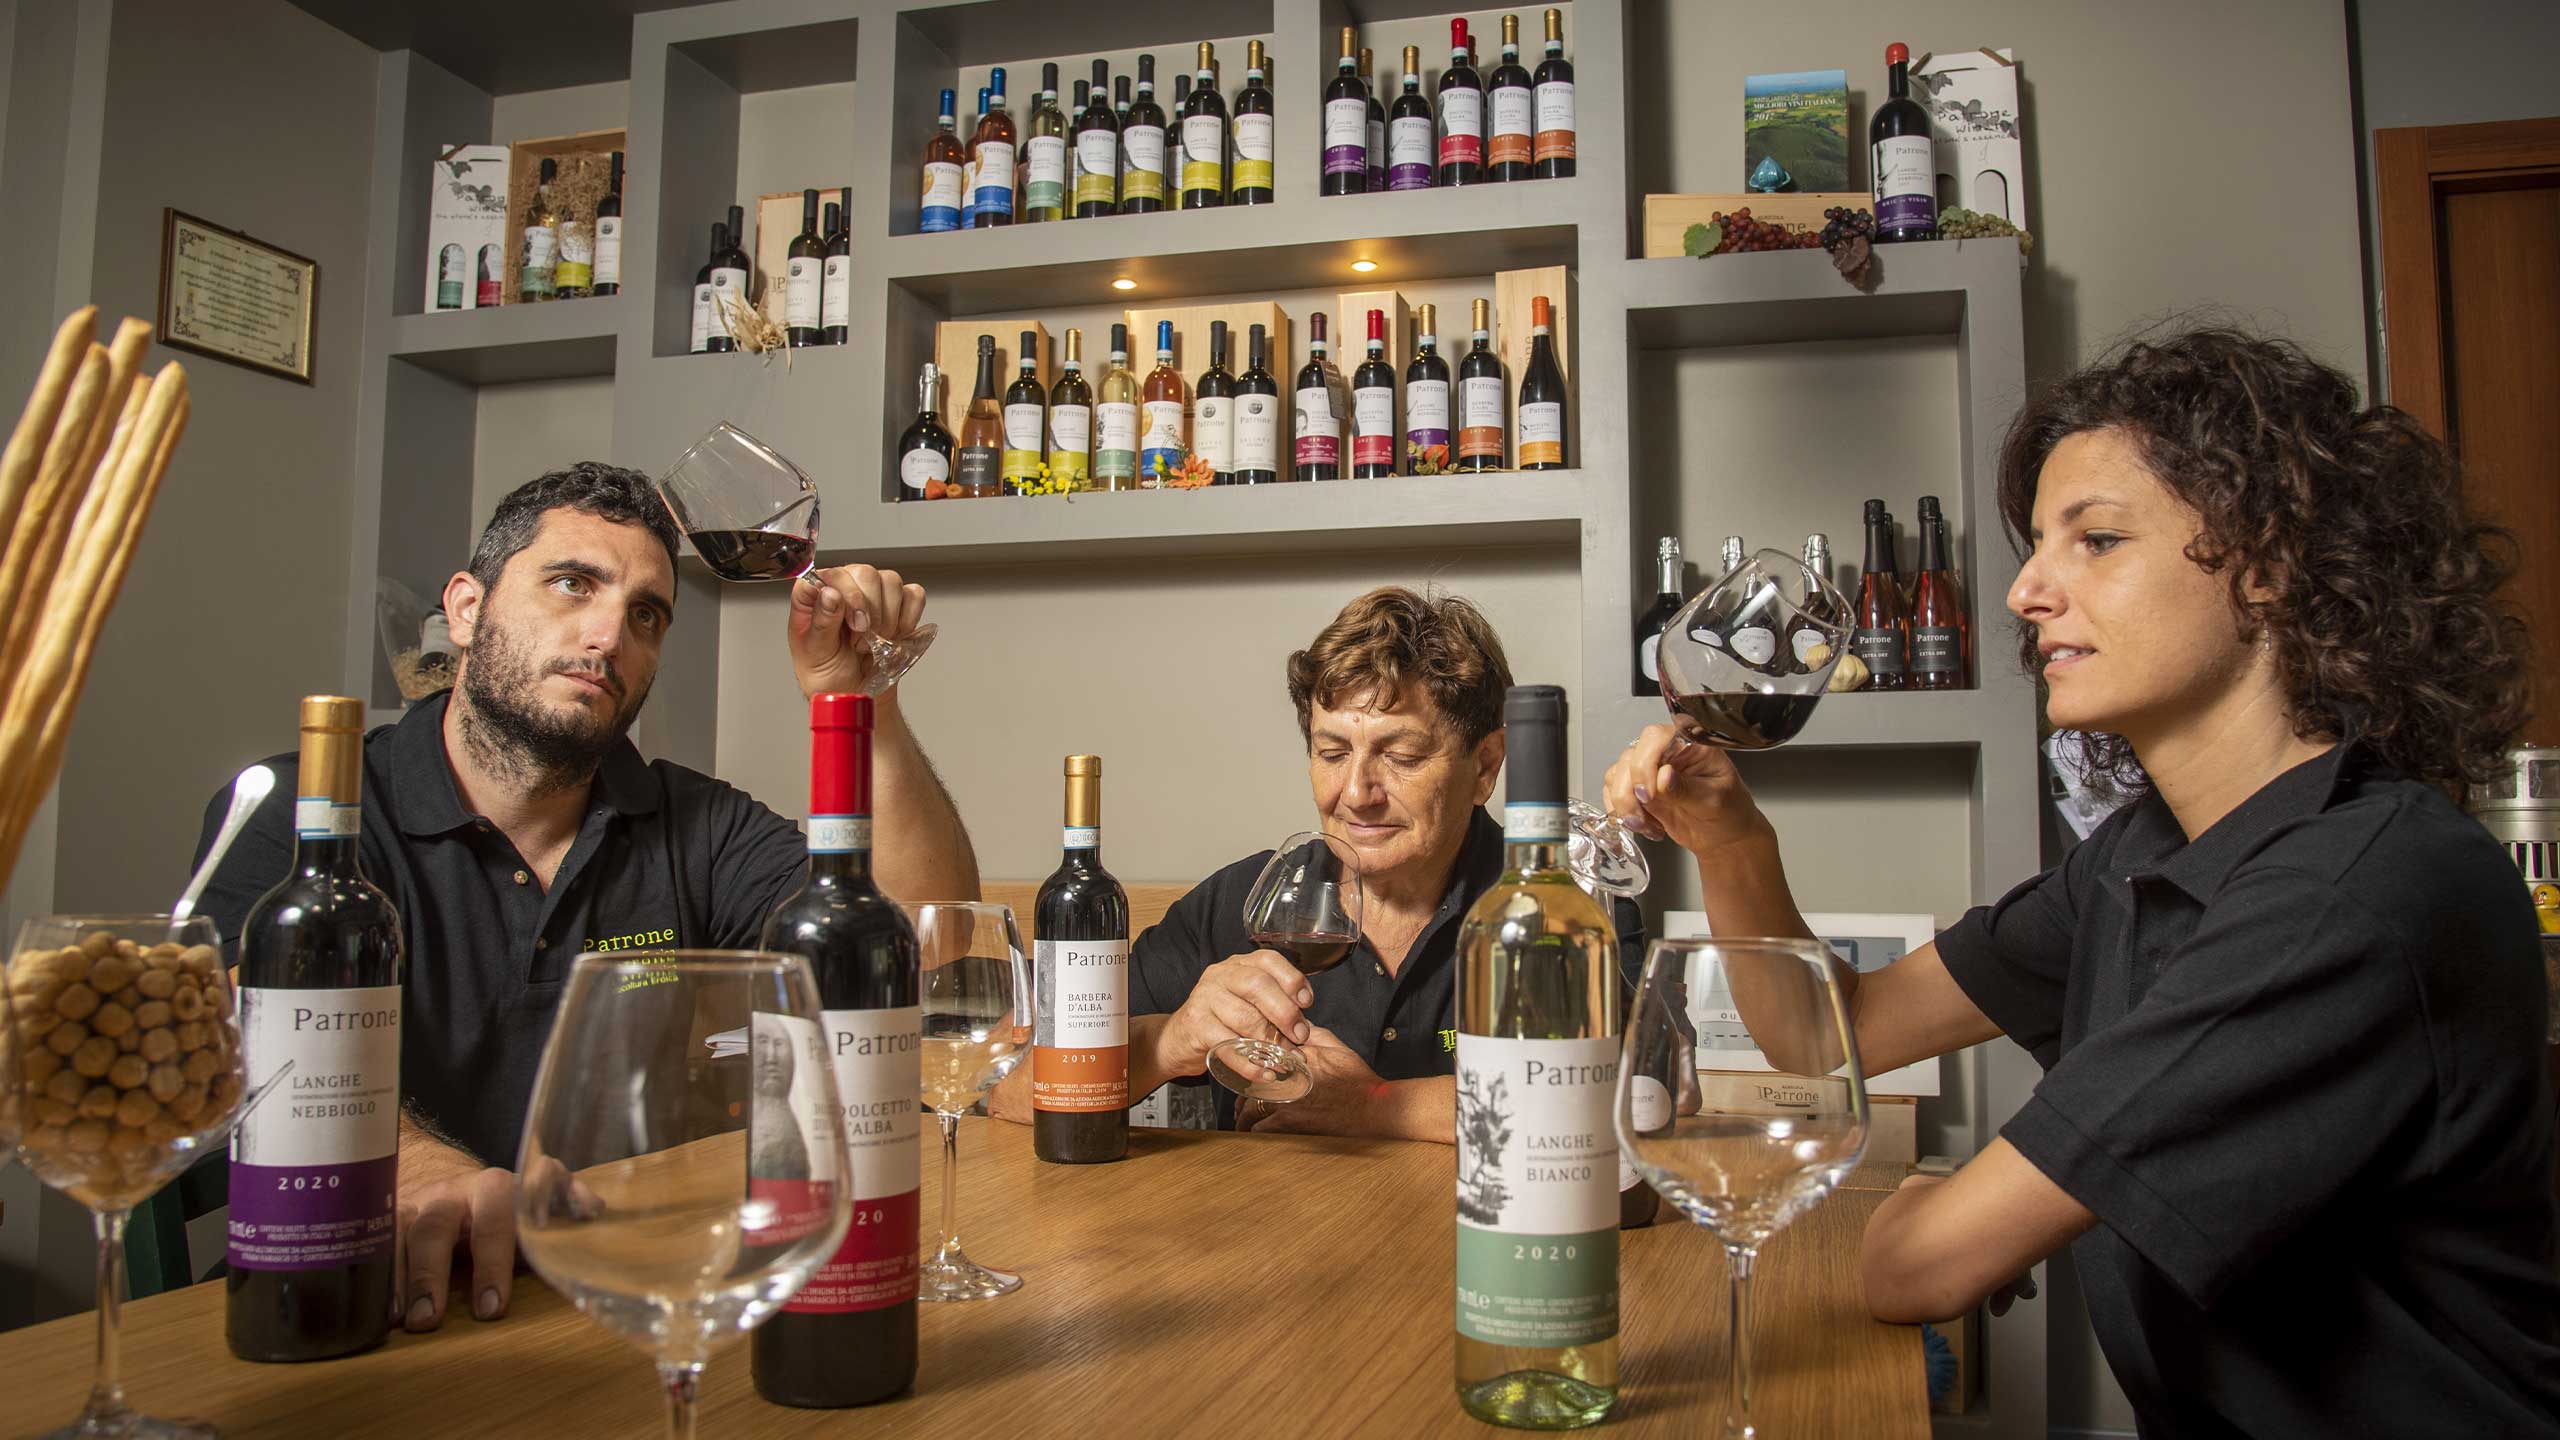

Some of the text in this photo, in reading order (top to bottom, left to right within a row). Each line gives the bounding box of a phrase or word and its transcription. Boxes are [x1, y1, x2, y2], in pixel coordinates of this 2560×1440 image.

[1896, 146, 1928, 156] Patrone
[1416, 385, 1447, 393] Patrone
[1471, 382, 1501, 390] Patrone
[1360, 392, 1391, 401] Patrone
[962, 452, 989, 461] Patrone
[1860, 635, 1892, 645] Patrone
[1917, 634, 1950, 643] Patrone
[583, 928, 675, 953] Patrone
[1067, 951, 1127, 967] Patrone
[1067, 992, 1113, 1002] BARBERA
[1067, 1003, 1103, 1012] D'ALBA
[294, 1007, 398, 1032] Patrone
[1067, 1020, 1111, 1029] SUPERIORE
[835, 1031, 921, 1056] Patron
[1061, 1054, 1097, 1063] 2019
[292, 1073, 362, 1090] LANGHE
[1762, 1086, 1820, 1102] Patrone
[291, 1100, 377, 1119] NEBBIOLO
[848, 1119, 894, 1137] 'ALBA
[1526, 1133, 1594, 1150] LANGHE
[1526, 1166, 1592, 1183] BIANCO
[277, 1175, 341, 1191] 2020
[857, 1209, 884, 1226] 20
[1514, 1244, 1577, 1261] 2020
